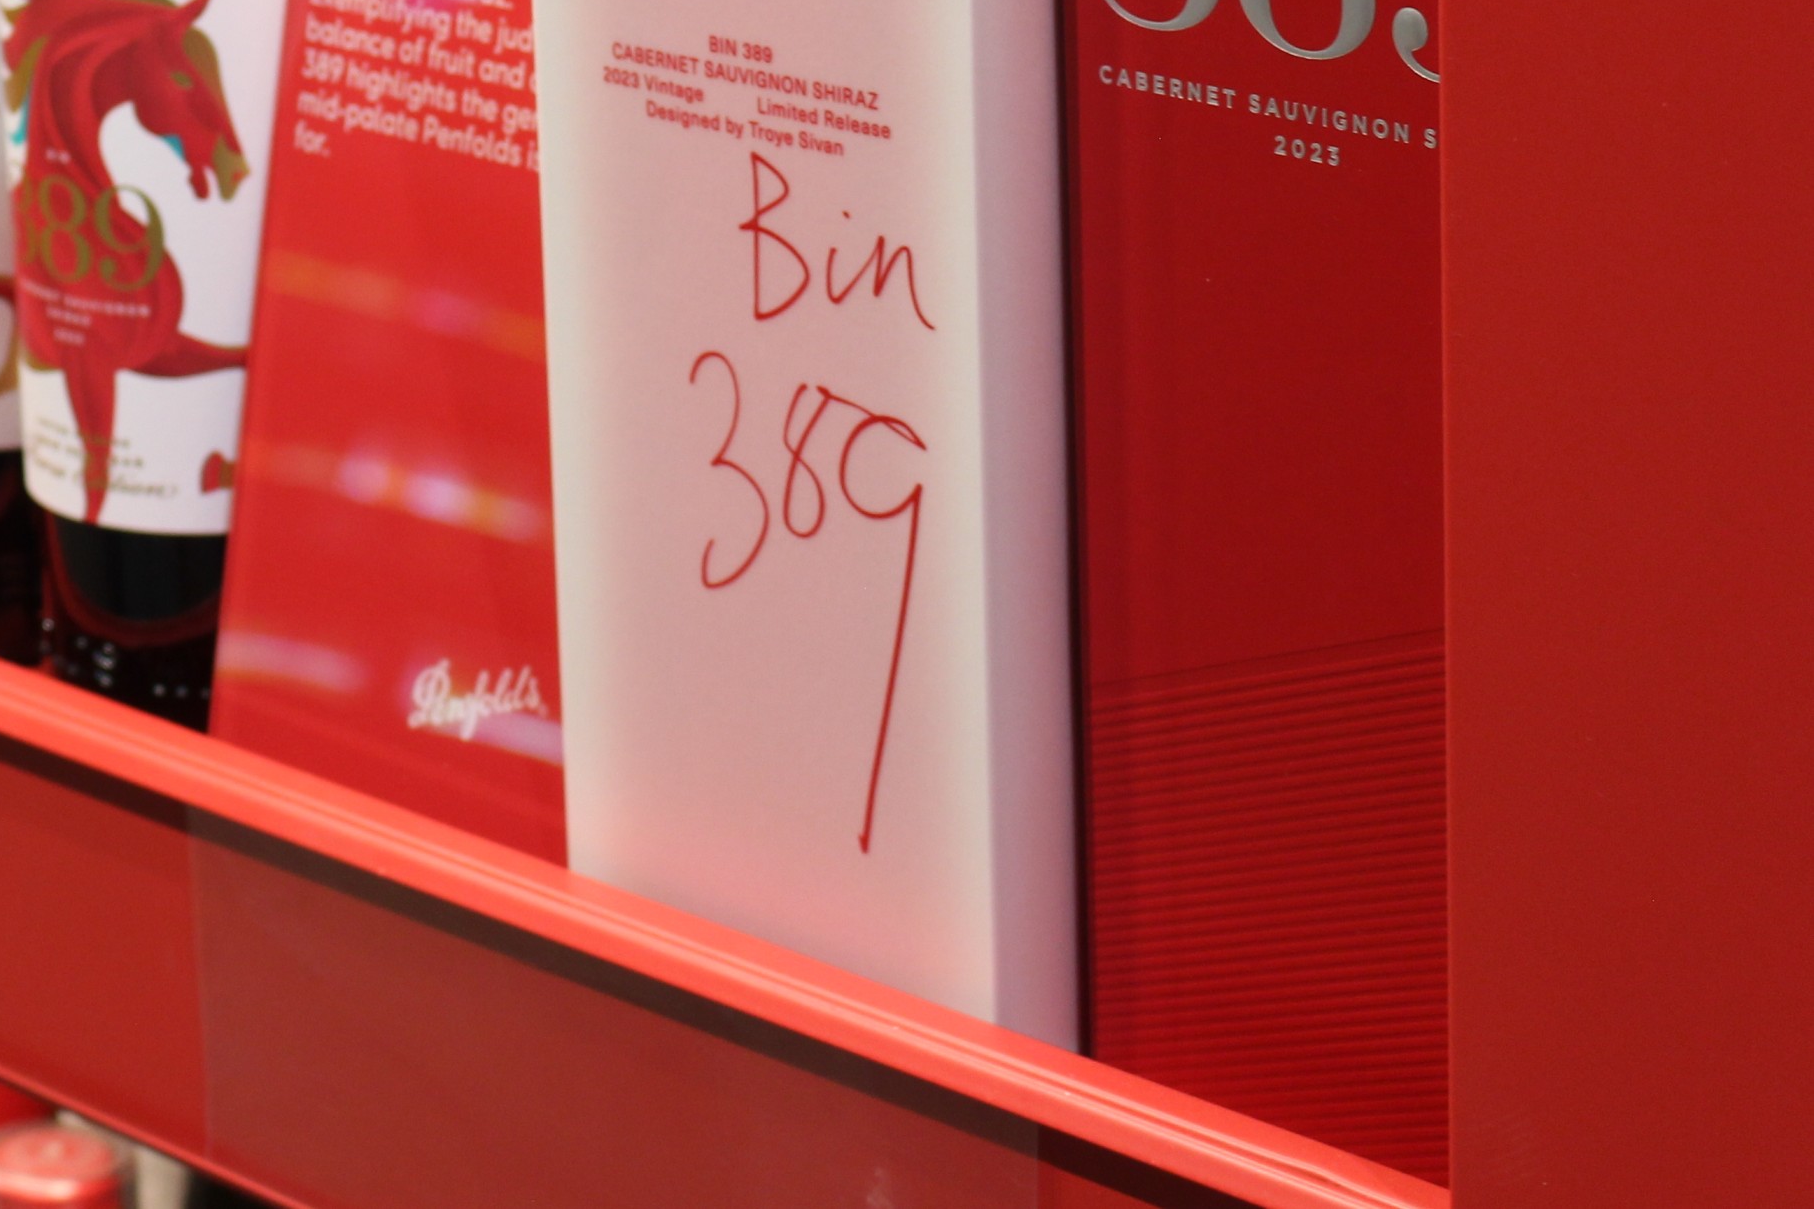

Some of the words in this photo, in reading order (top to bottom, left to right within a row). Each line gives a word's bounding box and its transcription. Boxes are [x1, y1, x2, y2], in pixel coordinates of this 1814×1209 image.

[304, 9, 397, 62] balance
[397, 35, 426, 66] of
[427, 39, 476, 80] fruit
[478, 60, 527, 91] and
[455, 7, 494, 45] the
[708, 34, 738, 58] BIN
[742, 41, 774, 65] 389
[301, 47, 347, 85] 389
[345, 57, 458, 114] highlights
[460, 87, 499, 124] the
[602, 65, 641, 90] 2023
[643, 72, 705, 106] Vintage
[756, 96, 819, 127] Limited
[823, 109, 892, 141] Release
[611, 41, 700, 76] CABERNET
[703, 59, 808, 98] SAUVIGNON
[811, 80, 880, 111] SHIRAZ
[1098, 64, 1237, 109] CABERNET
[1248, 93, 1411, 144] SAUVIGNON
[1423, 126, 1441, 150] S
[296, 86, 420, 143] mid-palate
[422, 113, 524, 169] Penfolds
[645, 99, 722, 132] Designed
[724, 116, 745, 140] by
[748, 120, 794, 148] Troye
[797, 130, 845, 157] Sivan
[1273, 135, 1341, 168] 2023
[738, 150, 937, 332] Bin
[689, 349, 928, 856] 389
[406, 656, 549, 743] Penfolds
